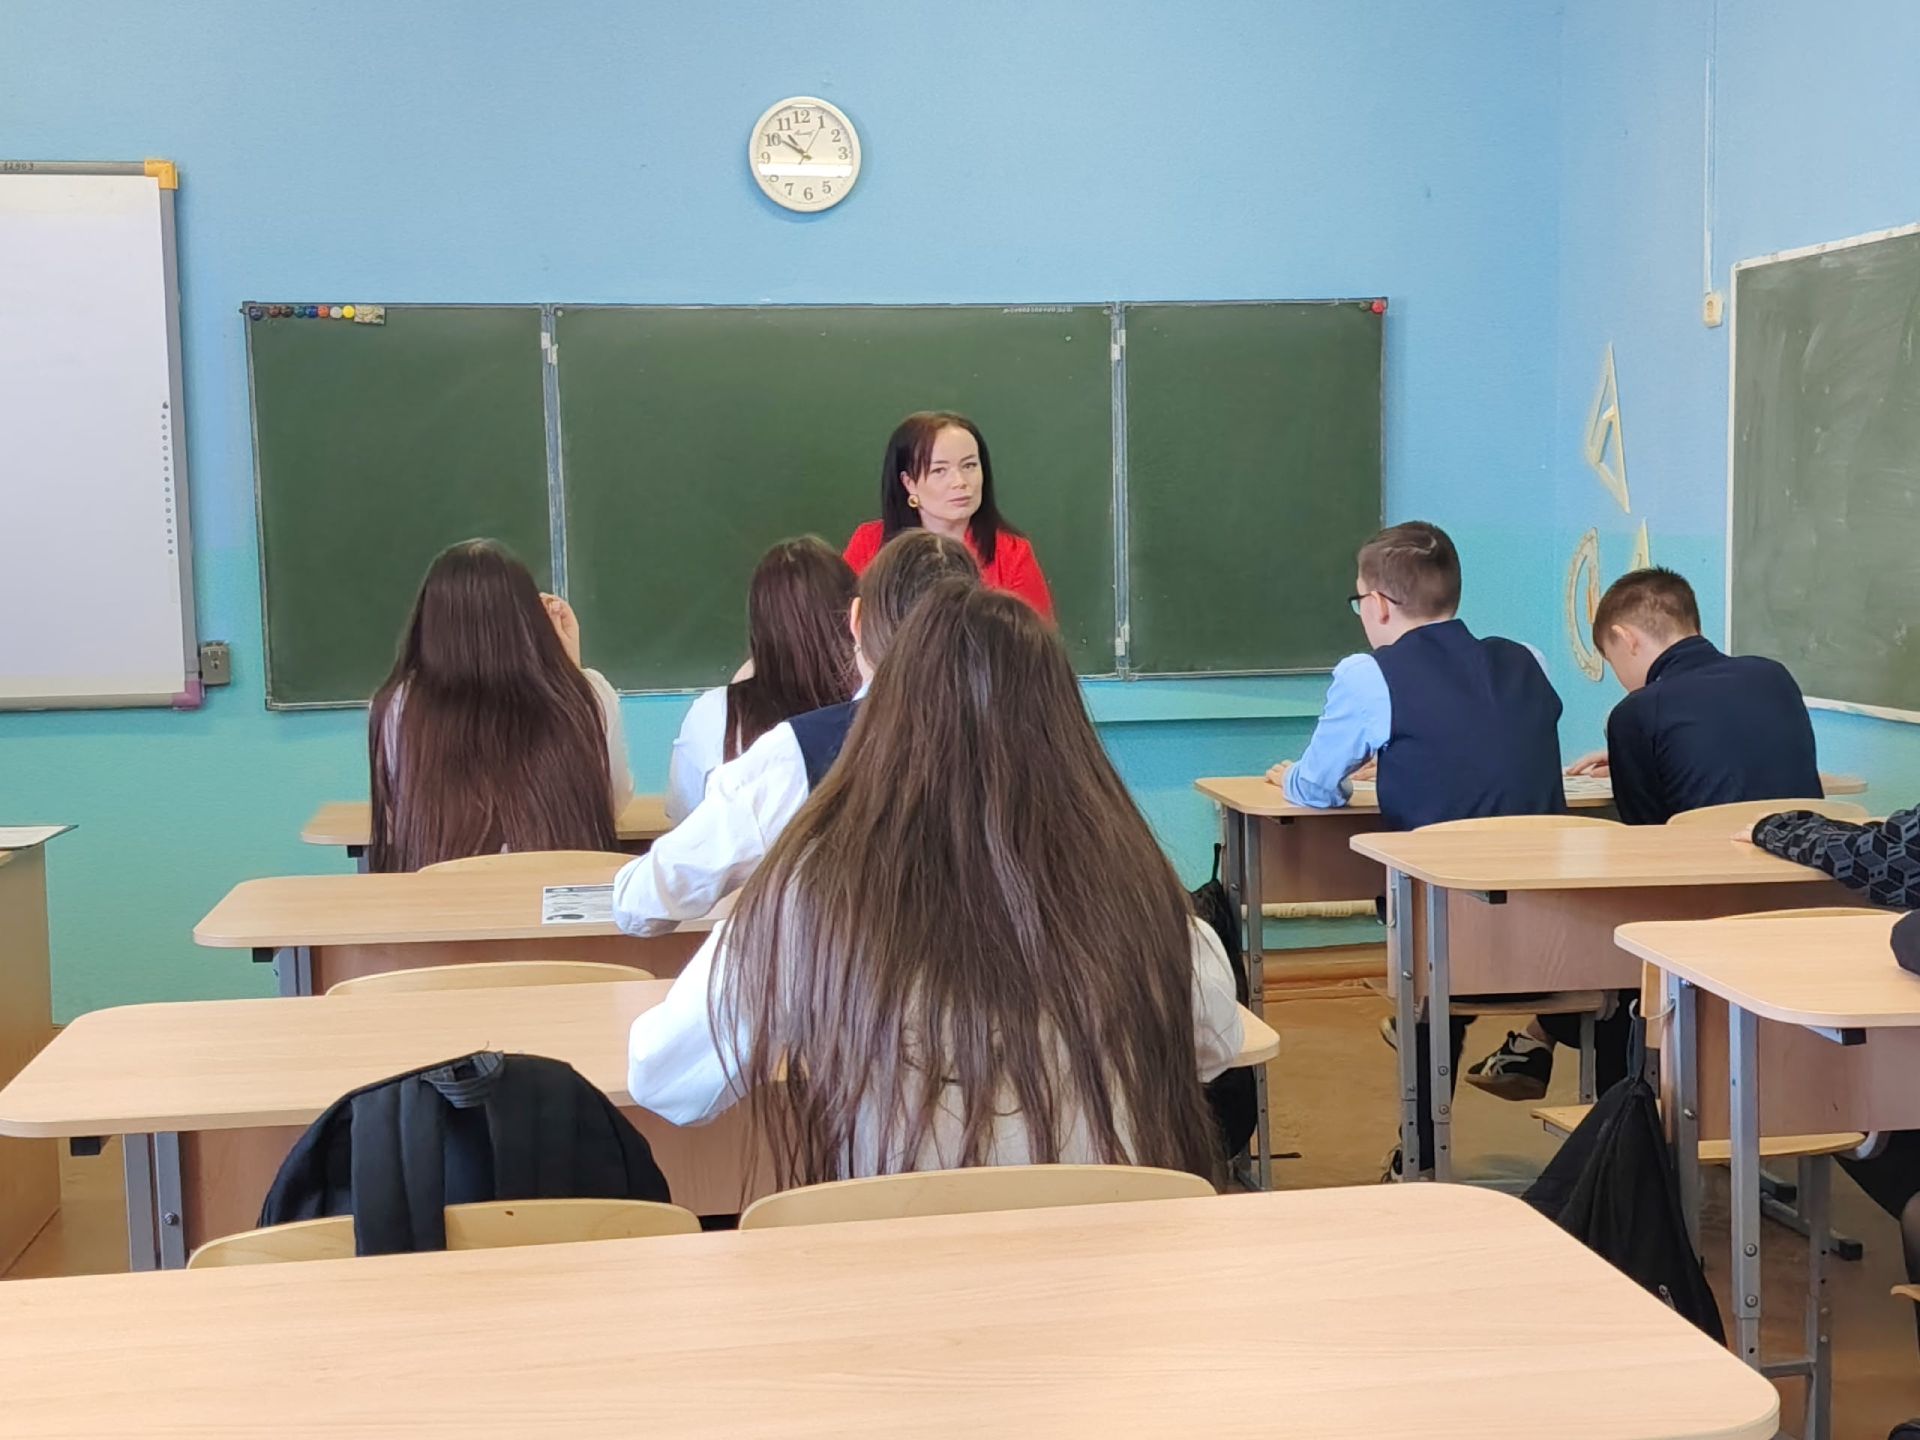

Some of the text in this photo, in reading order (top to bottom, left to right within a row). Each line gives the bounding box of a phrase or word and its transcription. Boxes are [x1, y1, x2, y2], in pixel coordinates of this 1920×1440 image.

[777, 116, 792, 131] 11
[793, 109, 811, 124] 12
[817, 115, 826, 129] 1
[766, 132, 782, 147] 10
[831, 129, 842, 143] 2
[761, 151, 771, 164] 9
[838, 146, 849, 160] 3
[784, 182, 794, 196] 7
[803, 187, 814, 201] 6
[822, 181, 832, 194] 5
